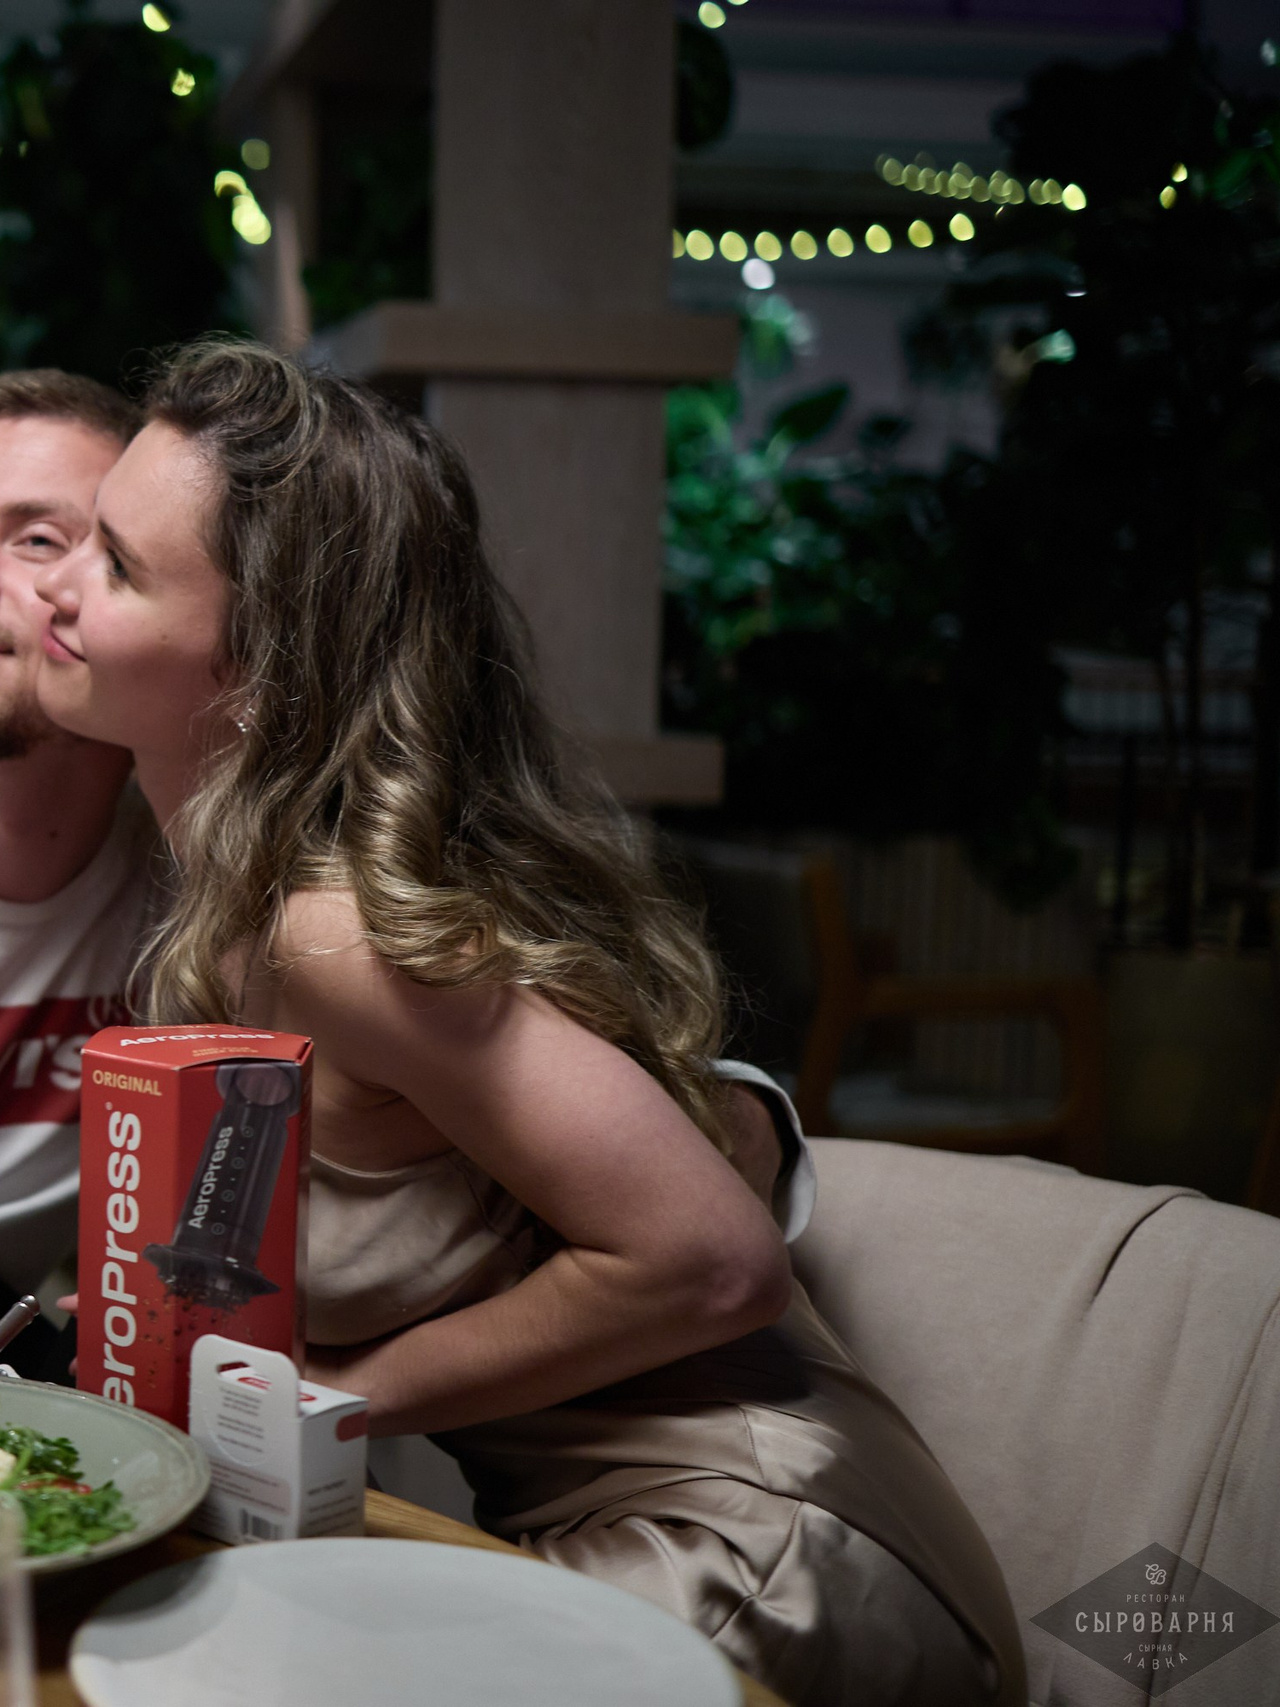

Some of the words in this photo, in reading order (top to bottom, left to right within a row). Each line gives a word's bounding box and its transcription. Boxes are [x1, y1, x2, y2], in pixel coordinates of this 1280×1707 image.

[120, 1032, 275, 1047] AeroPress
[92, 1069, 162, 1097] ORIGINAL
[188, 1126, 234, 1229] AeroPress
[101, 1110, 142, 1406] eroPress
